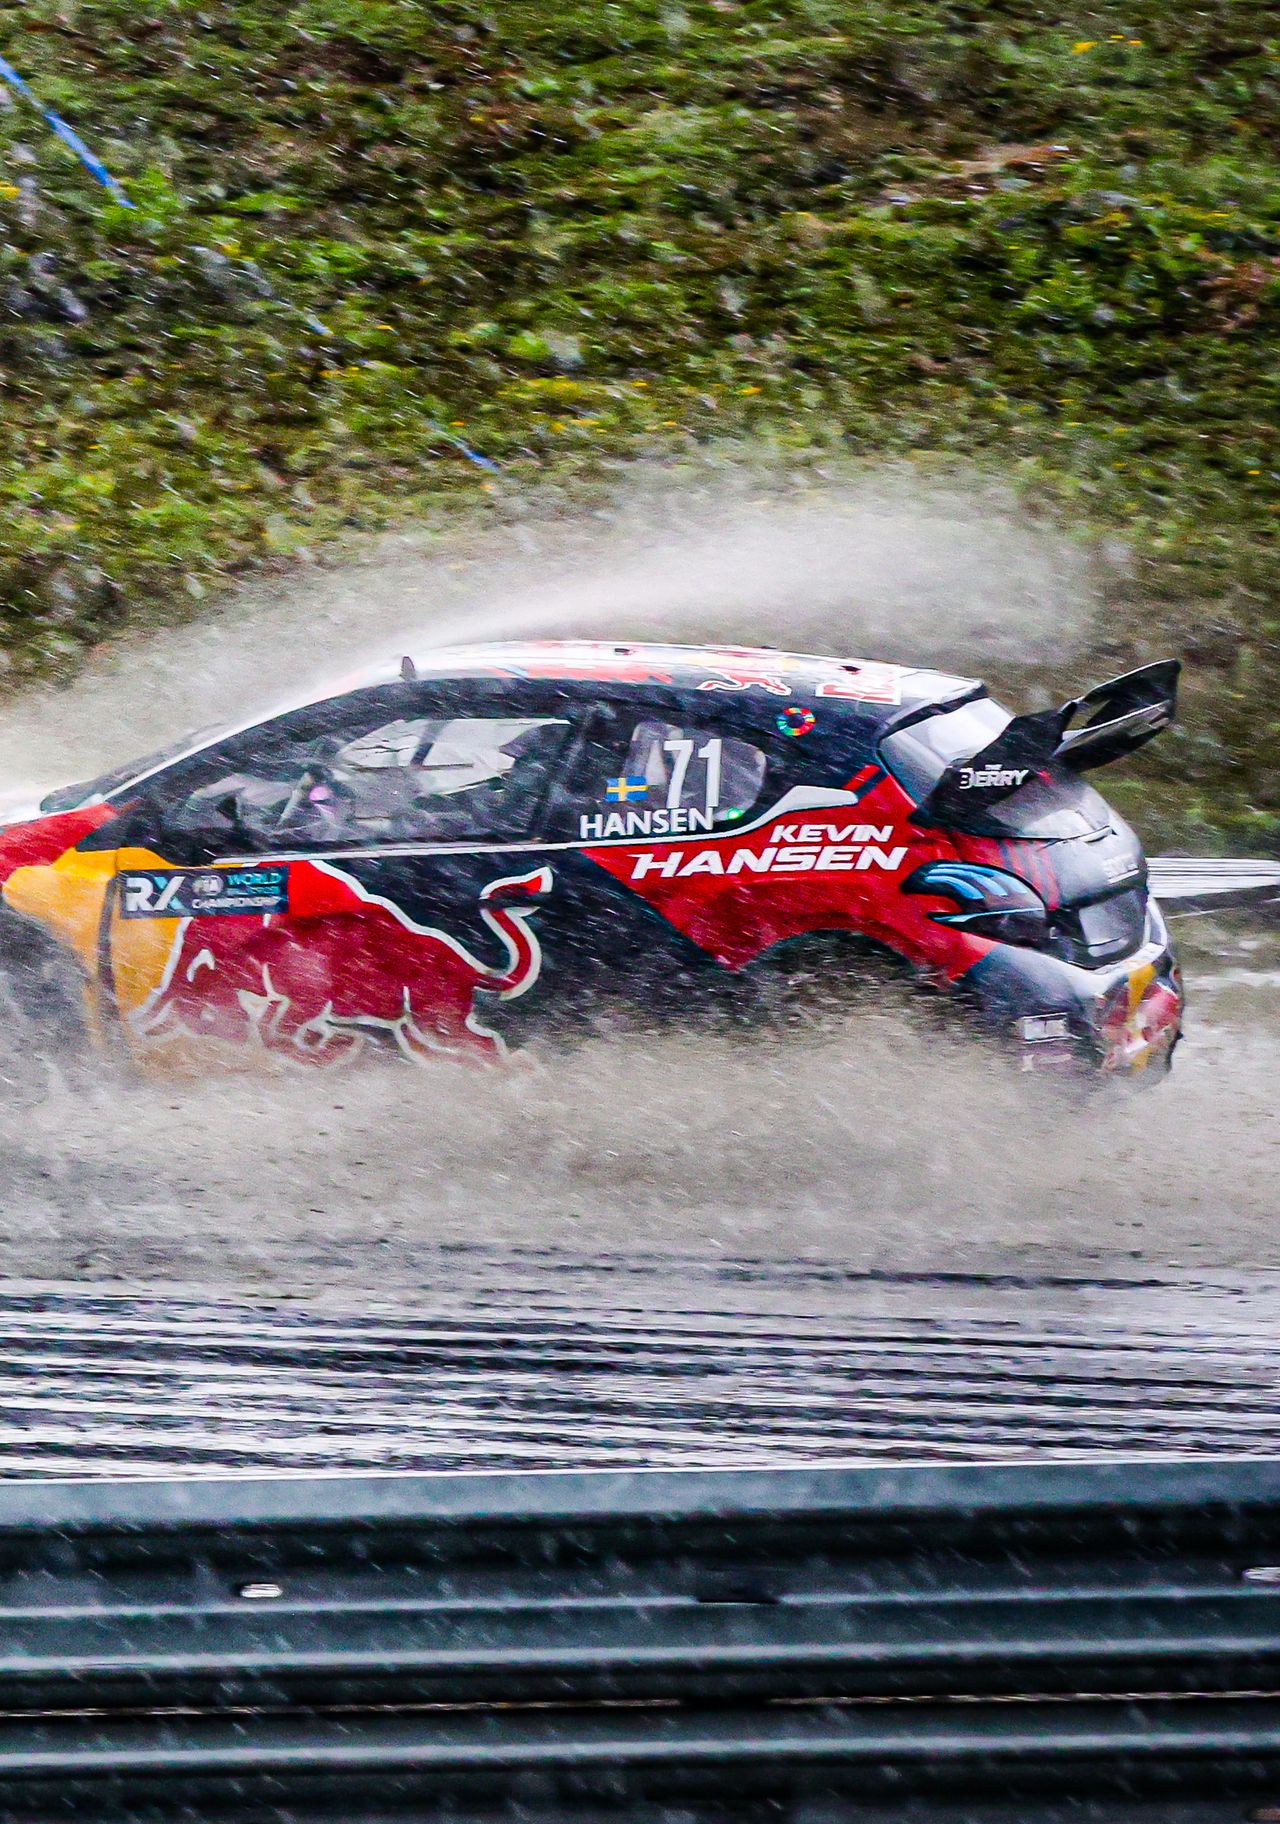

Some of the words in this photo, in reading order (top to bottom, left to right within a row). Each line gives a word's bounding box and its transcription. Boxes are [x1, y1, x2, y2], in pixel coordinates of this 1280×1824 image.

[663, 738, 722, 808] 71
[579, 807, 714, 839] HANSEN
[769, 824, 894, 843] KEVIN
[626, 846, 909, 879] HANSEN
[127, 876, 186, 912] RX
[227, 873, 282, 885] WORLD
